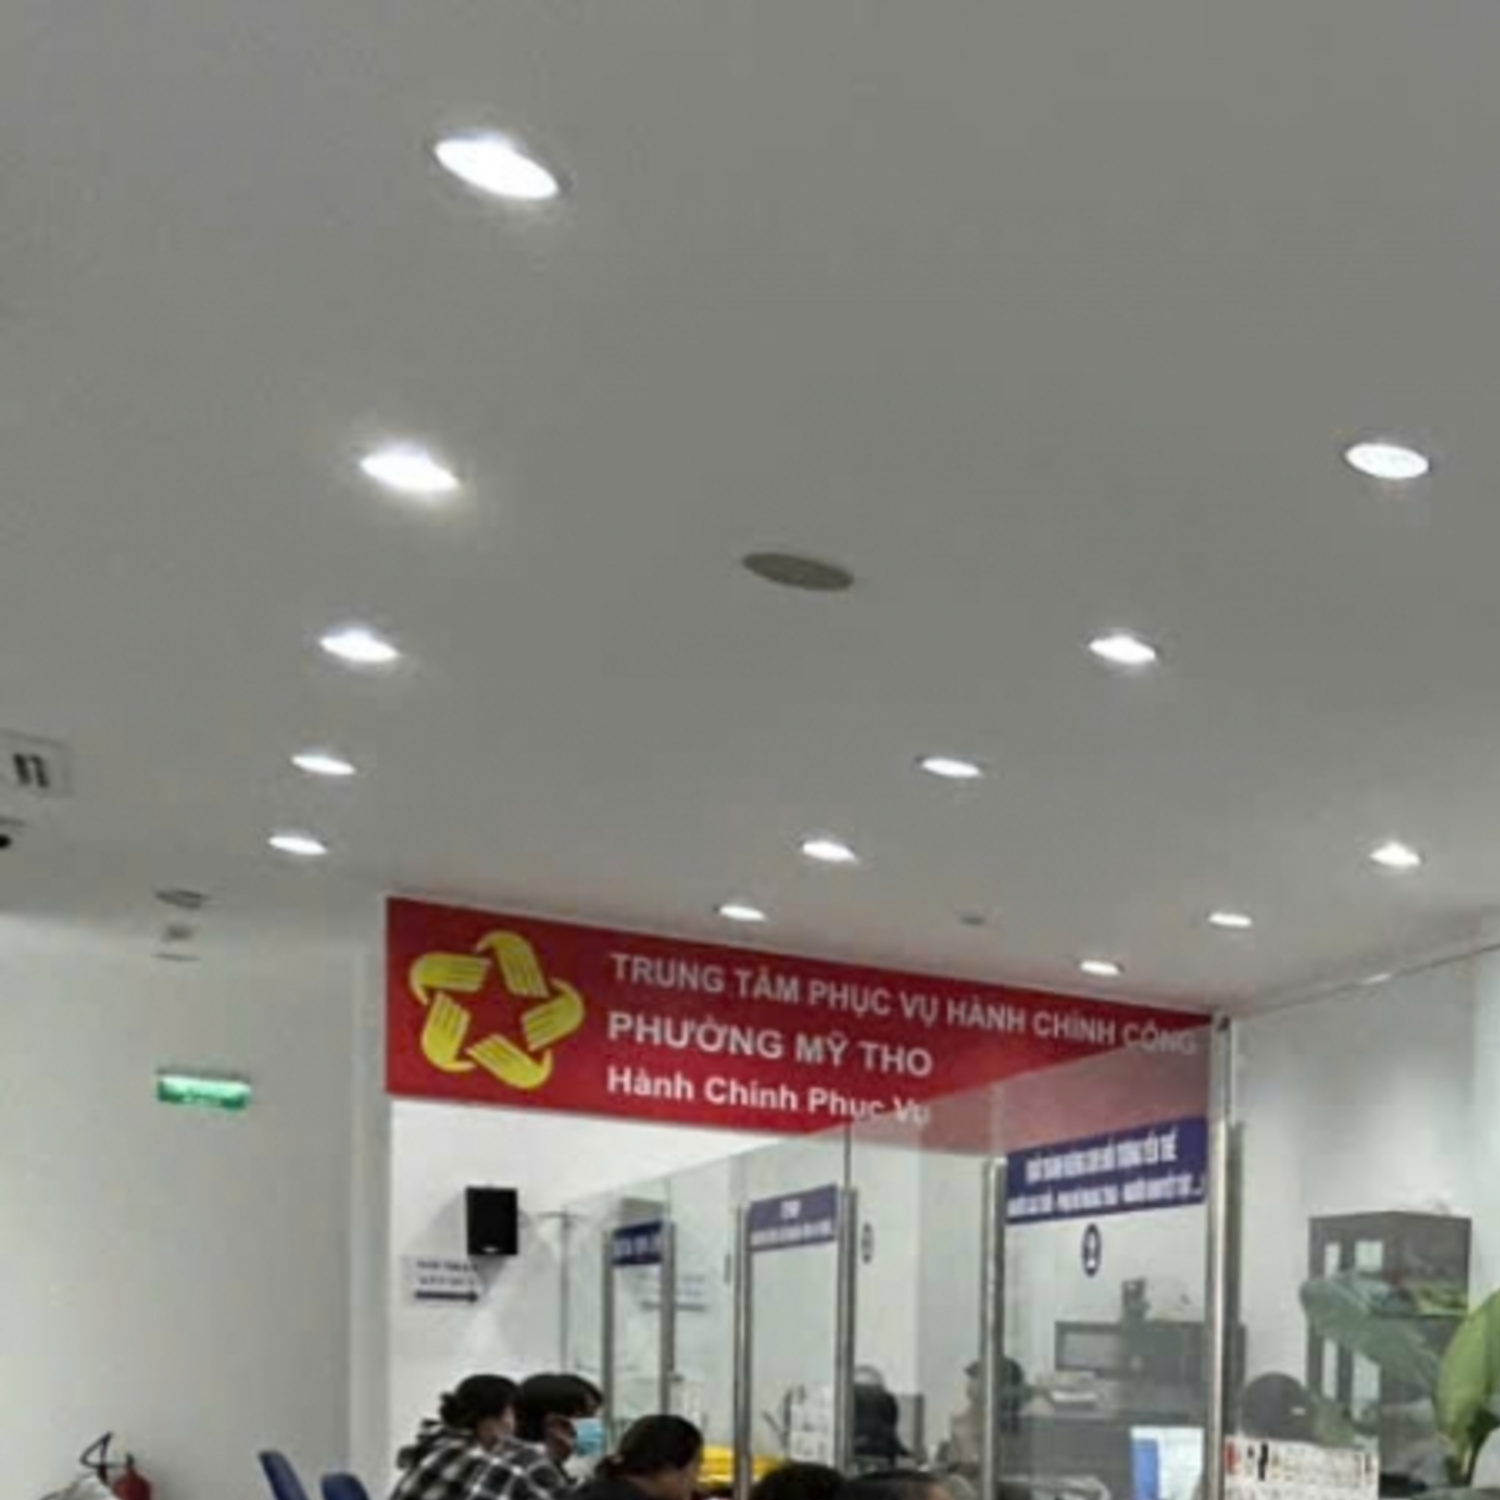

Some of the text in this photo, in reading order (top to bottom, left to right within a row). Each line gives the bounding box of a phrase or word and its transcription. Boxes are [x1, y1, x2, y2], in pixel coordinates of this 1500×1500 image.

[610, 952, 1197, 1055] TRUNG TÂM PHỤC VỤ HÀNH CHÍNH CÔNG
[608, 1010, 933, 1077] PHƯỜNG MỸ THO
[607, 1066, 695, 1101] Hành
[704, 1075, 798, 1112] Chính
